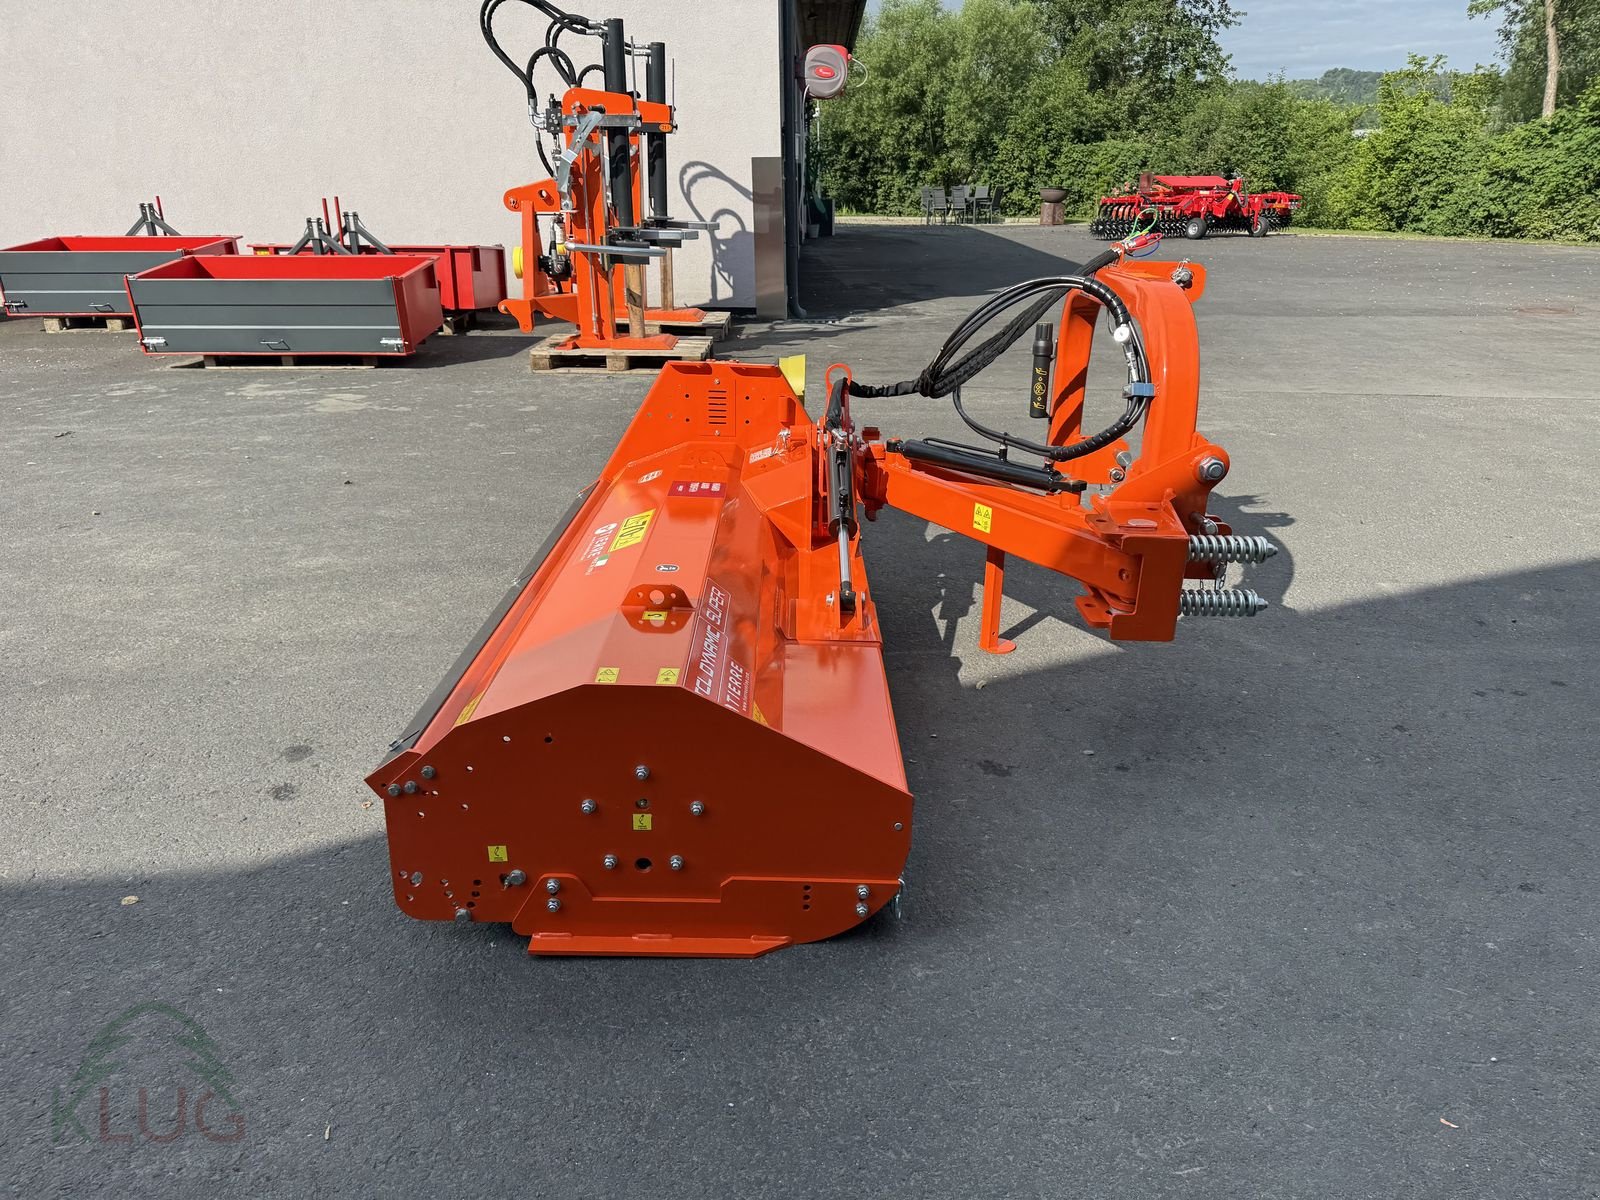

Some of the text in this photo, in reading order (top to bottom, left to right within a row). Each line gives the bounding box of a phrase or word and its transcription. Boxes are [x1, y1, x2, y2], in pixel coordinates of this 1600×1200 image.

[706, 586, 726, 626] SUPER
[699, 624, 721, 678] DYNAMIC
[726, 660, 744, 708] TIERRE
